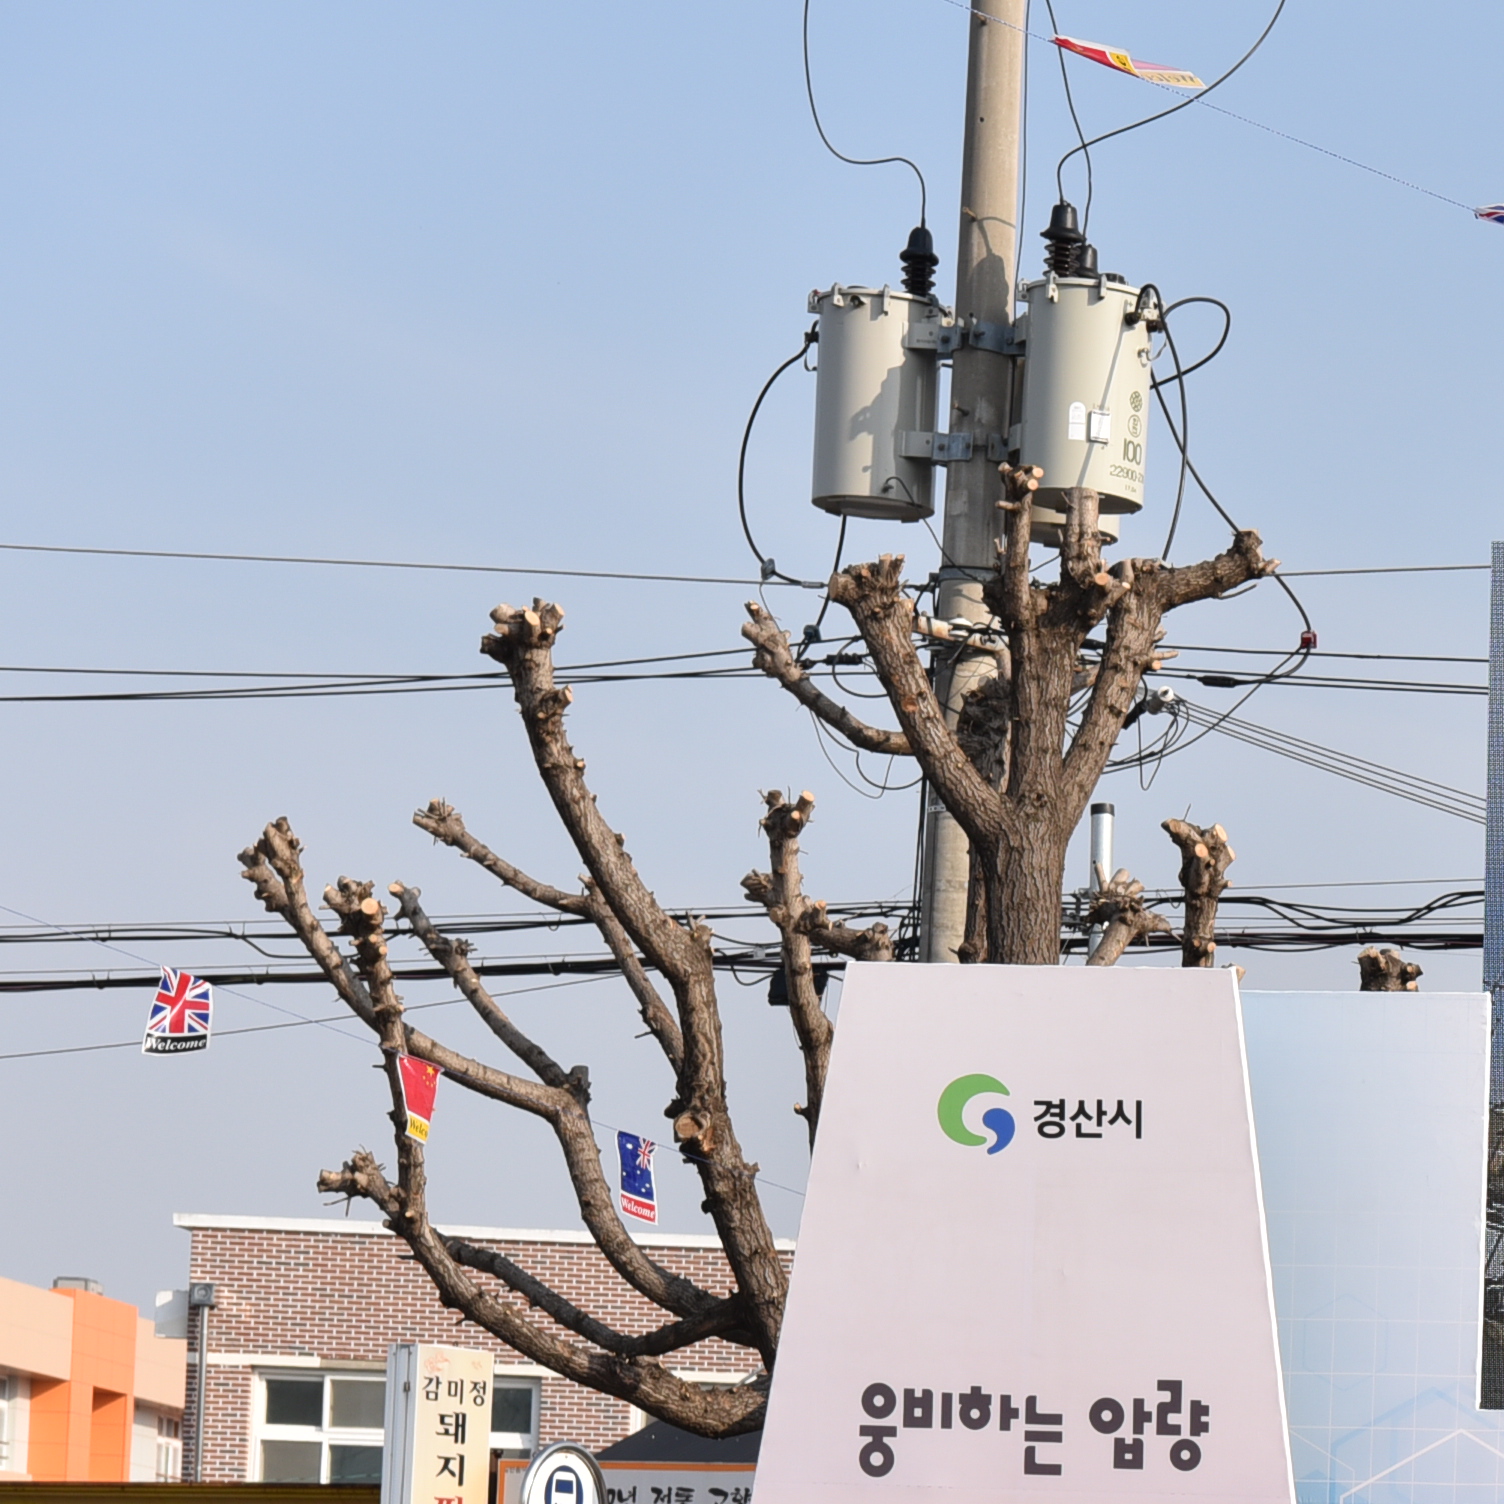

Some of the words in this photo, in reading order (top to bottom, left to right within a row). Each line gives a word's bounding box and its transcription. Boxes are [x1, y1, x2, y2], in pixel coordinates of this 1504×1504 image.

[144, 1034, 207, 1052] Welcome
[1032, 1098, 1143, 1140] 경산시
[620, 1196, 656, 1220] Welcome
[421, 1375, 487, 1407] 감미정
[858, 1382, 1064, 1478] 웅비하는
[1088, 1379, 1211, 1473] 압량
